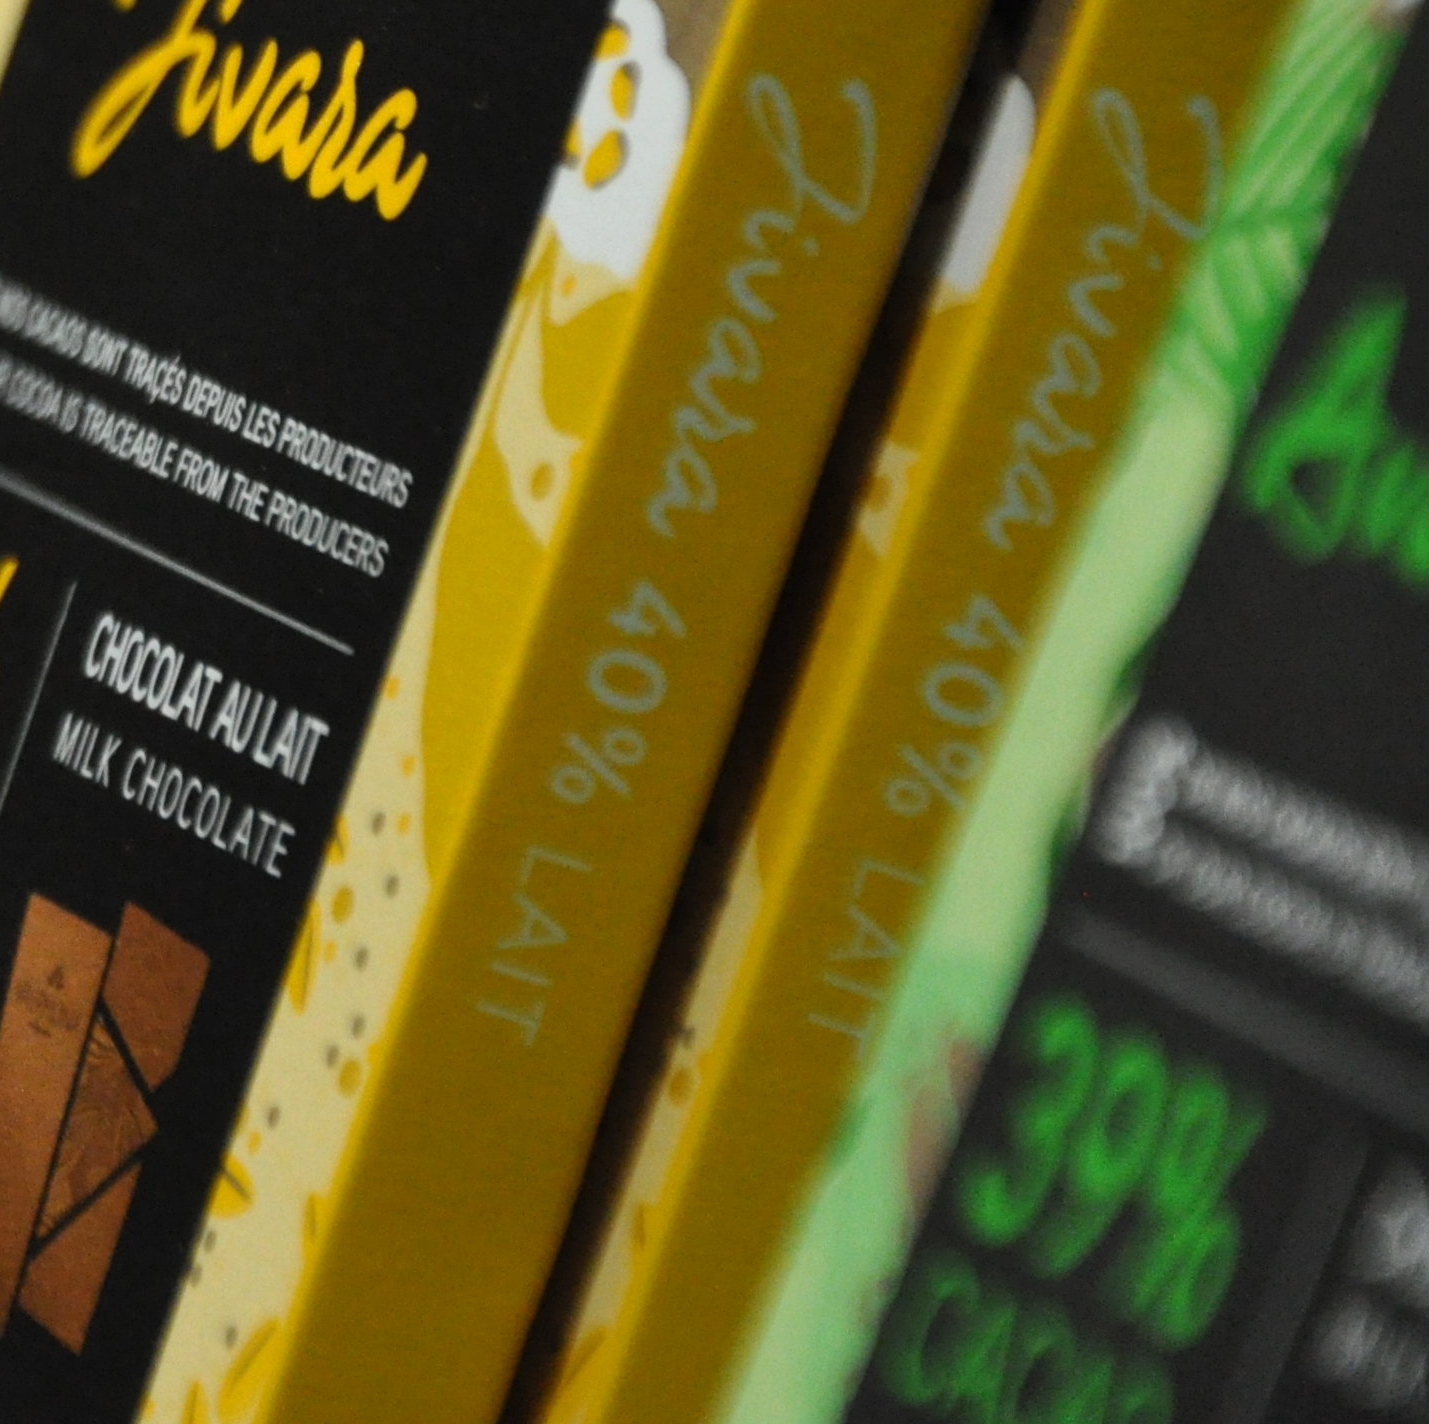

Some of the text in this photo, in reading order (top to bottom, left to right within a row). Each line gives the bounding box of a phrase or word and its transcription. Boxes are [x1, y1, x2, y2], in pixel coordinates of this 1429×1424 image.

[983, 87, 1224, 554] Jivara
[79, 398, 178, 478] TRACEABLE
[173, 446, 230, 503] FROM
[227, 471, 269, 522] THE
[264, 490, 389, 577] PRODUCERS
[80, 326, 128, 376] SONT
[181, 374, 247, 433] DEPUIS
[242, 402, 281, 448] LES
[276, 418, 414, 508] PRODUCTEURS
[476, 72, 878, 1049] Jivara 40% LAIT
[84, 613, 330, 786] CHOCOLAT AU LAIT
[881, 592, 1025, 818] 40%
[52, 711, 296, 879] MILK CHOCOLATE
